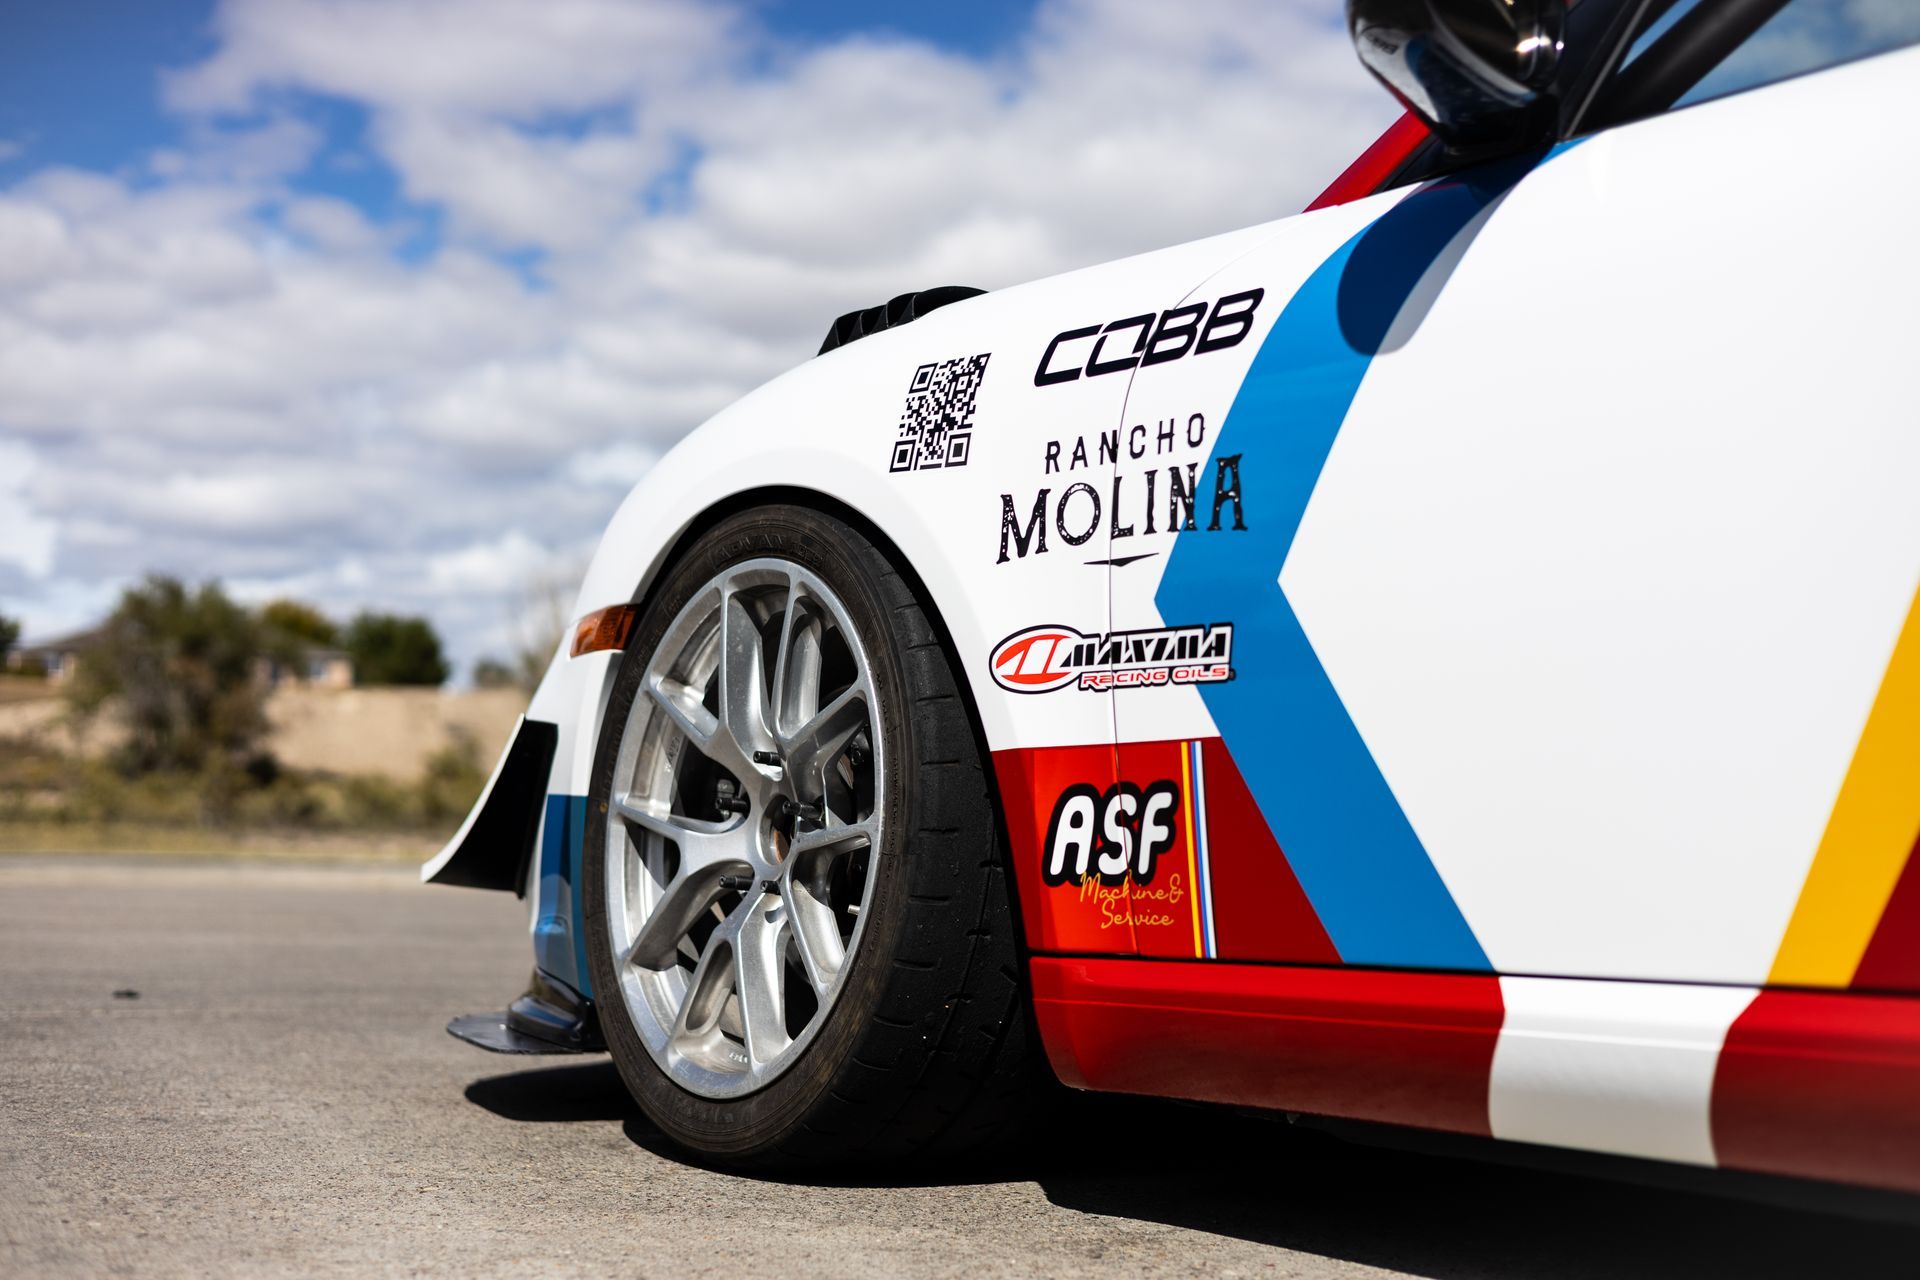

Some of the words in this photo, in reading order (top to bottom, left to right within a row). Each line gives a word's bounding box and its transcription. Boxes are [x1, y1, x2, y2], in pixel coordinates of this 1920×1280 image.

[1034, 288, 1265, 387] COBB
[1045, 413, 1206, 475] RANCHO
[996, 453, 1249, 565] MOLINA
[1059, 629, 1230, 668] MAXIMA
[1082, 668, 1168, 687] RACING
[1174, 665, 1228, 680] OILS
[1048, 790, 1174, 876] ASF
[1100, 897, 1175, 929] Service
